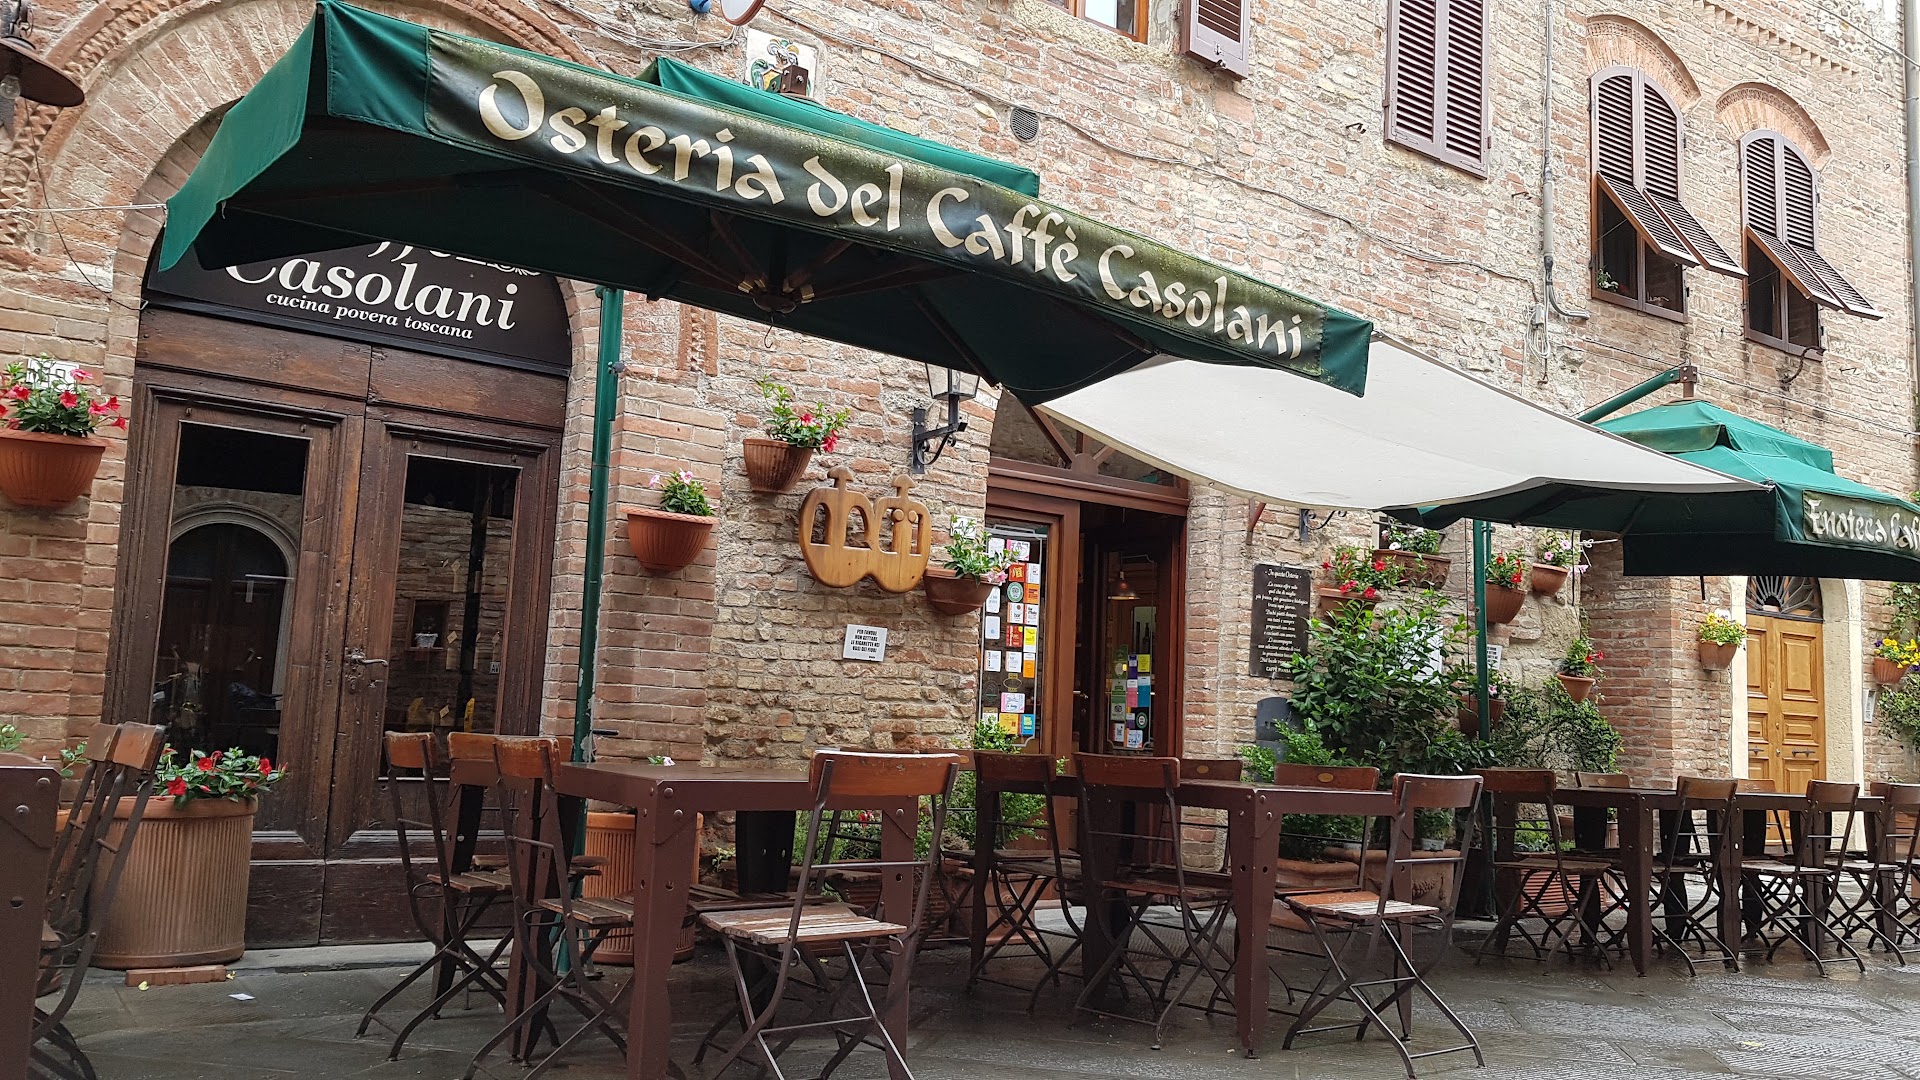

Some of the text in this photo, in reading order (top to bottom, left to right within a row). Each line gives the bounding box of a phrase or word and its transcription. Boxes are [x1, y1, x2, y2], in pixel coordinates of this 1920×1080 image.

[479, 69, 1303, 360] Osteria del Caffè Casolani
[266, 292, 474, 341] cucina povera toscana
[1807, 499, 1920, 551] Enoteca Caf
